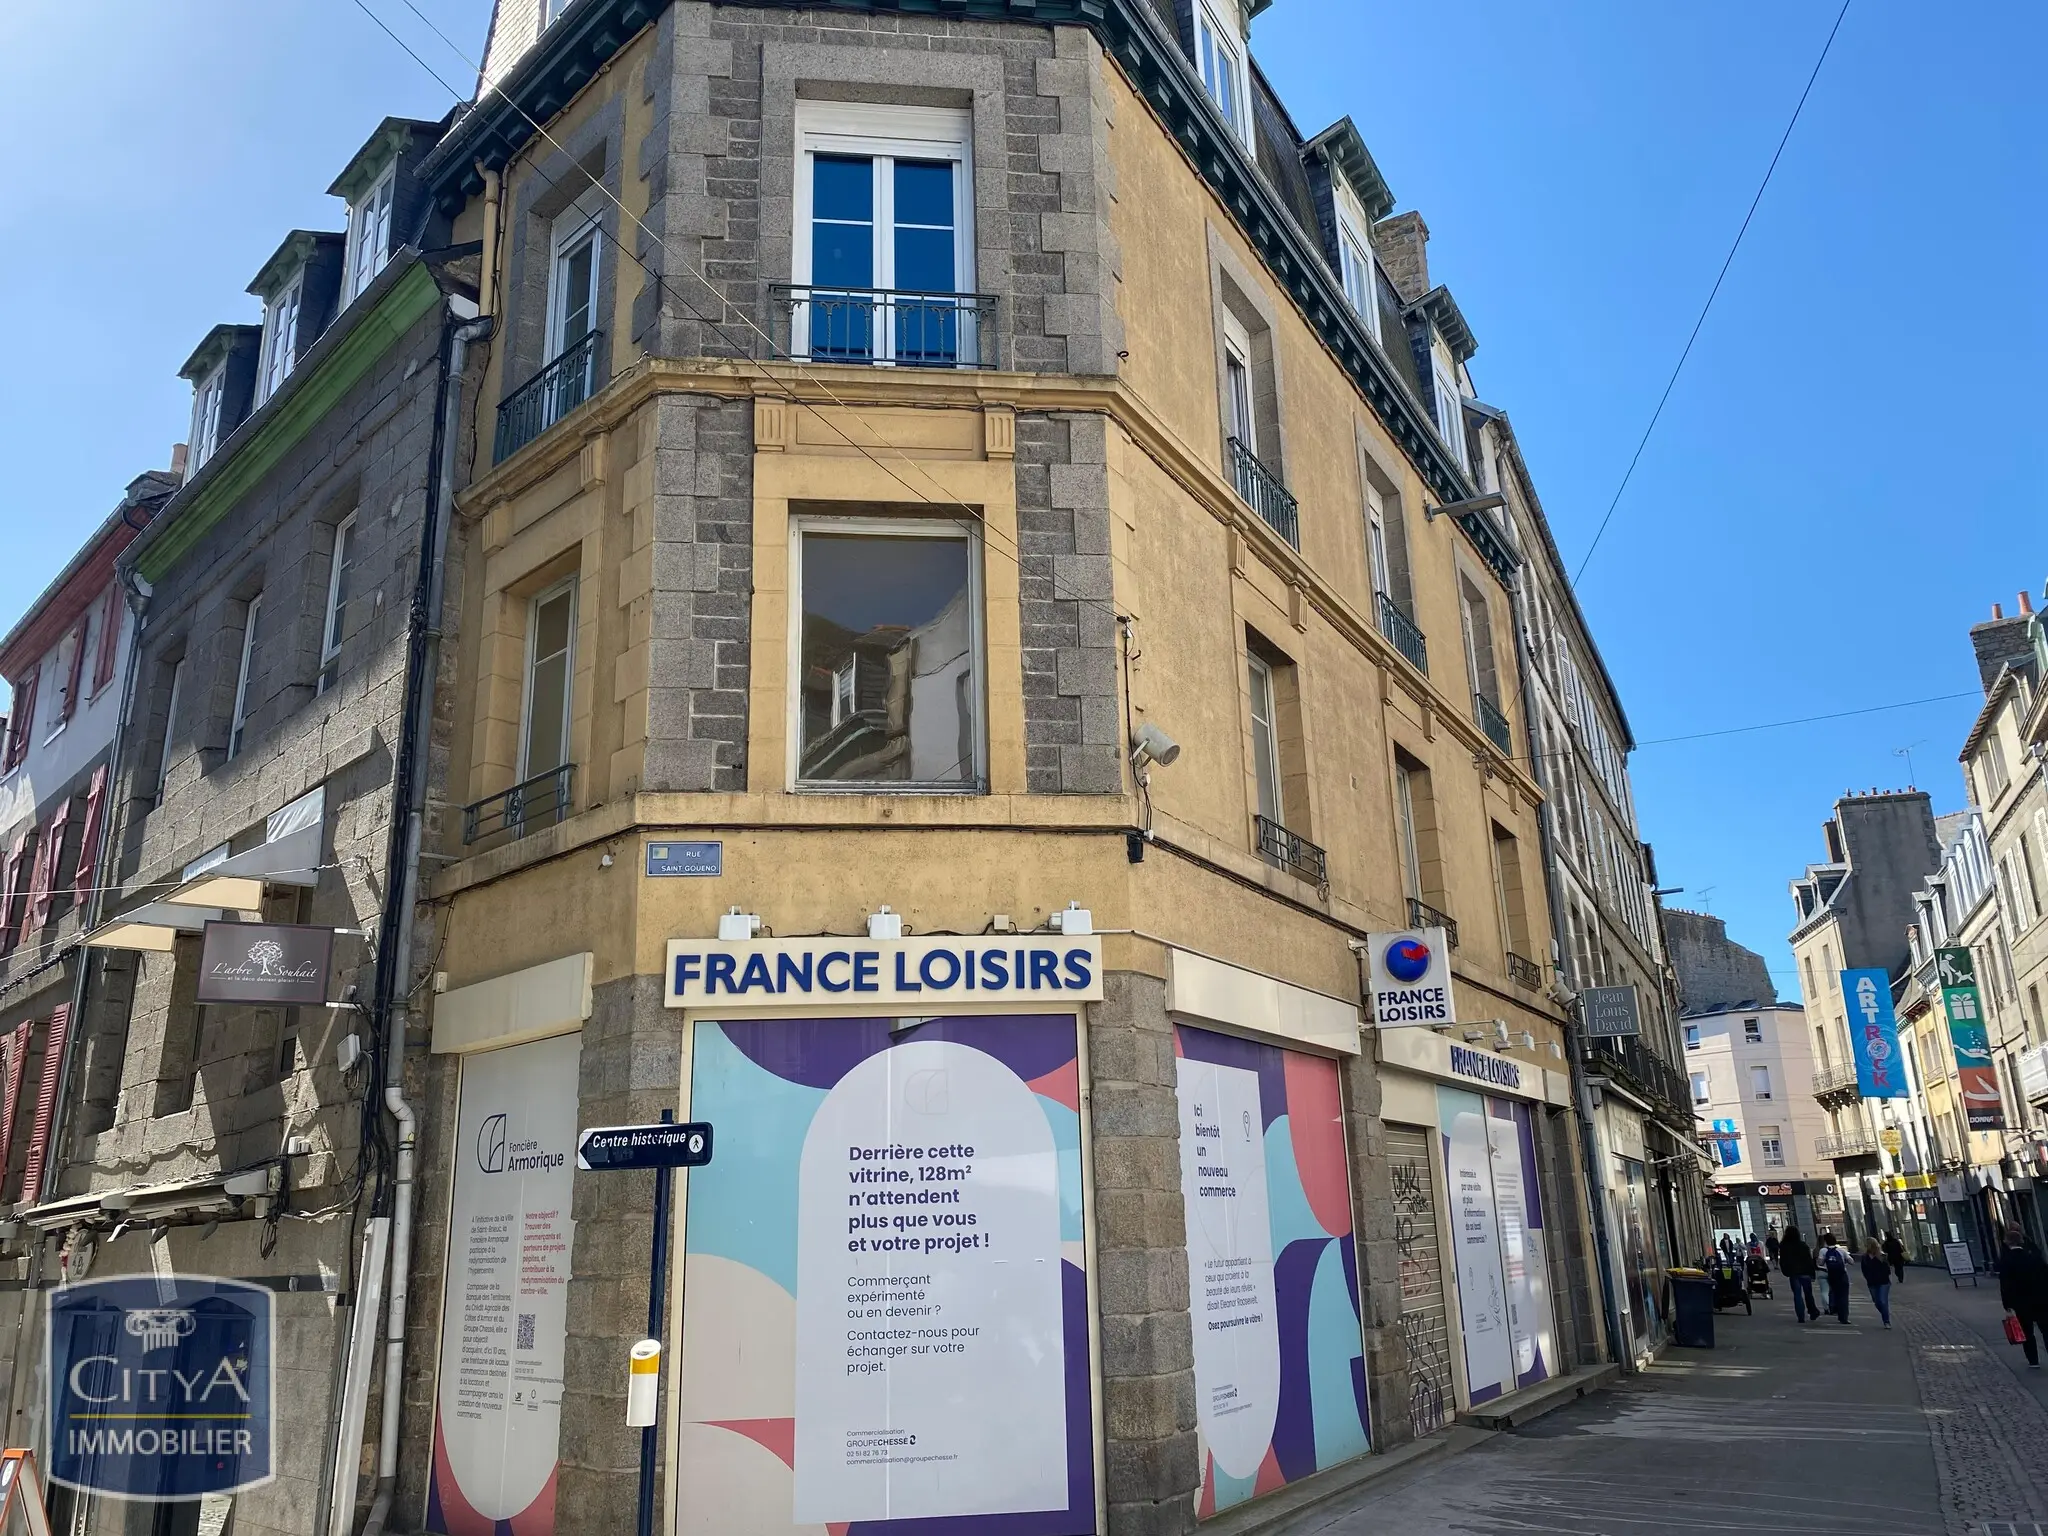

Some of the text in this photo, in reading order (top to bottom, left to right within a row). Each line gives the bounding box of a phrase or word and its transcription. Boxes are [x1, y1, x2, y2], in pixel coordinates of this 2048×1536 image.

[274, 960, 317, 978] Souhait
[674, 949, 1092, 996] FRANCE LOISIRS
[1378, 987, 1444, 1006] FRANCE
[1595, 990, 1624, 1004] Jean
[1856, 977, 1880, 1024] ART
[1379, 1004, 1446, 1022] LOISIRS
[1595, 1004, 1629, 1018] Louis
[1595, 1016, 1632, 1032] David
[1865, 1025, 1891, 1088] ROCK
[1451, 1045, 1520, 1089] FRANCE LOISIRS
[1194, 1104, 1203, 1117] Ici
[1195, 1123, 1220, 1138] bientôt
[509, 1140, 538, 1152] Foncière
[593, 1131, 686, 1148] Centre historique
[849, 1144, 975, 1161] Derrière cette
[1197, 1146, 1207, 1157] un
[508, 1151, 564, 1173] Armorique
[849, 1165, 972, 1184] vitrine, 128m²
[1198, 1166, 1228, 1177] nouveau
[849, 1189, 960, 1206] n’attendent
[1200, 1186, 1236, 1197] commerce
[848, 1213, 977, 1234] plus que vous
[848, 1232, 989, 1254] et votre projet !
[848, 1274, 931, 1288] Commerçant
[847, 1289, 925, 1305] expérimenté
[847, 1304, 942, 1318] ou en devenir ?
[1208, 1321, 1220, 1331] Osez
[1220, 1317, 1244, 1332] poursuivre
[1245, 1316, 1249, 1324] le
[847, 1327, 979, 1341] Contactez-nous pour
[847, 1342, 965, 1359] échanger sur votre
[847, 1361, 886, 1376] projet.
[846, 1429, 905, 1437] Commercialisation
